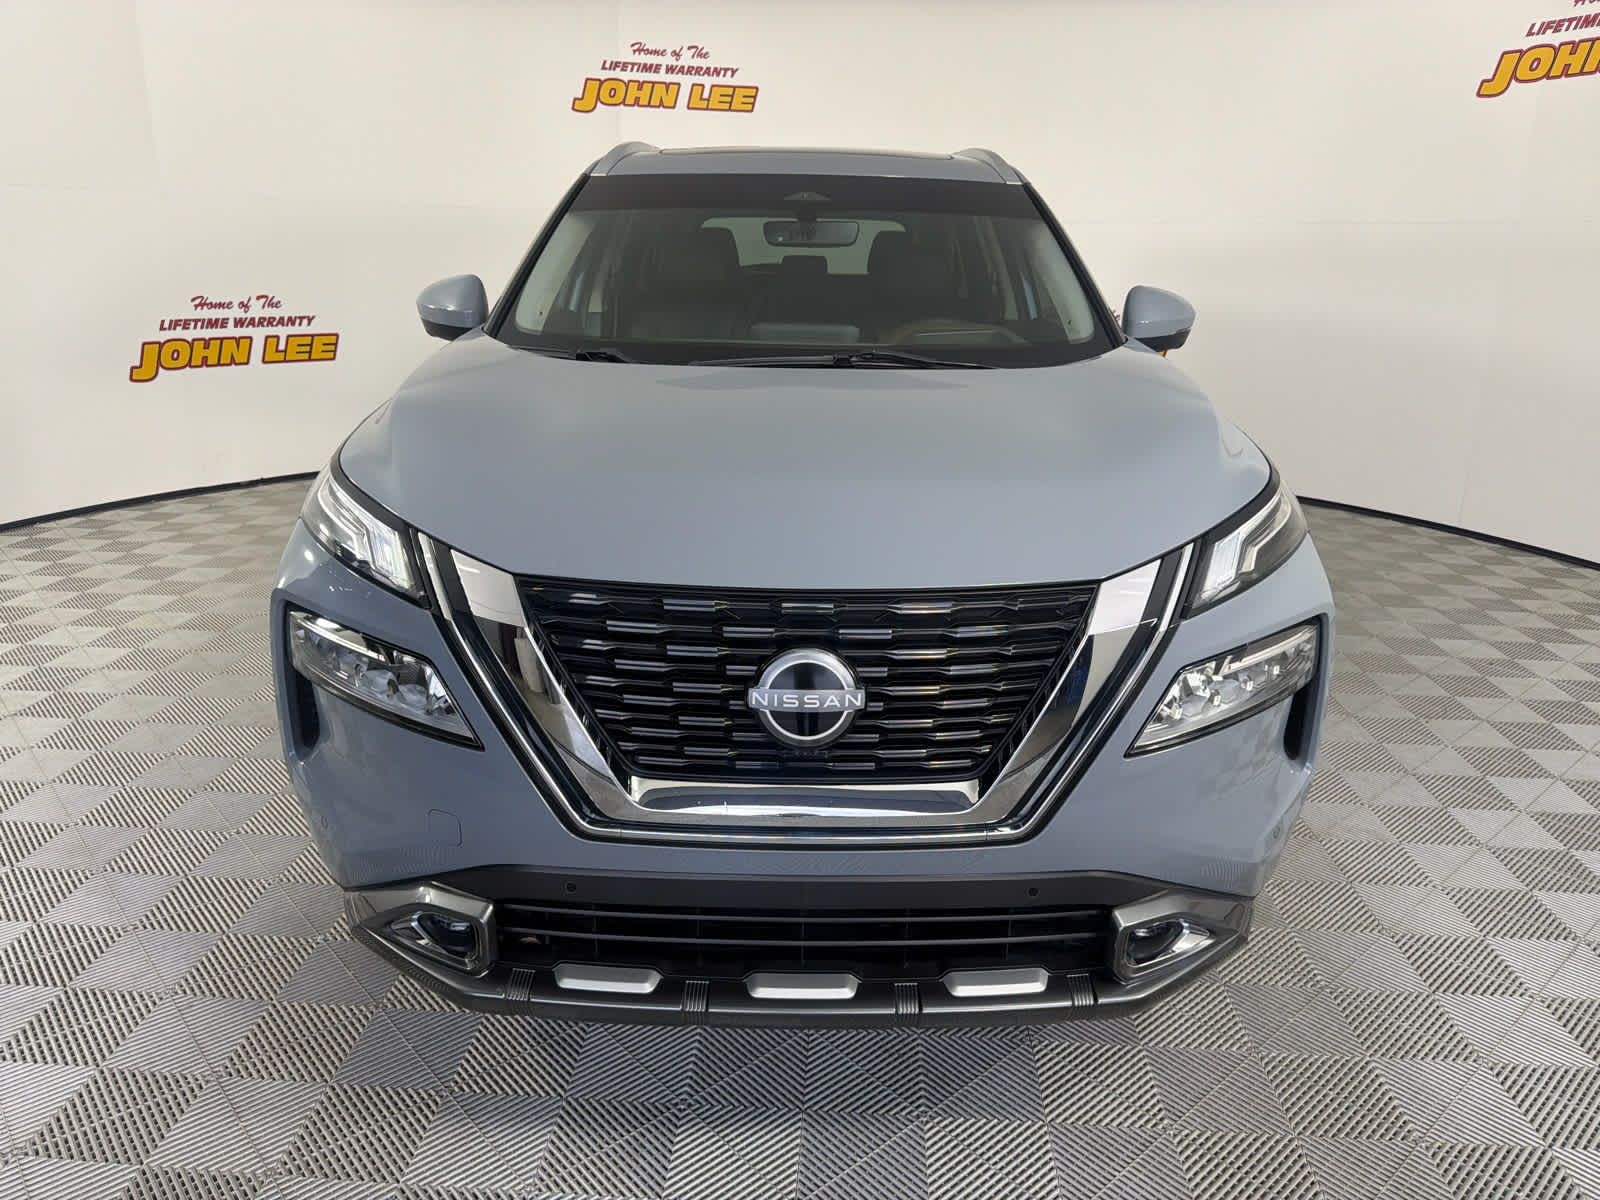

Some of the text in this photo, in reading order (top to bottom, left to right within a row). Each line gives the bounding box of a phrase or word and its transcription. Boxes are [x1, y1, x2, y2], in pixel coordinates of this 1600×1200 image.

[1525, 12, 1600, 37] LIFETIM
[630, 41, 711, 61] Home of The
[601, 60, 739, 78] LIFETIME WARRANTY
[572, 78, 759, 113] JOHN LEE
[190, 295, 283, 313] Home of The
[159, 315, 316, 332] LIFETIME WARRANTY
[129, 332, 339, 382] JOHN LEE
[751, 691, 862, 708] NISSAN
